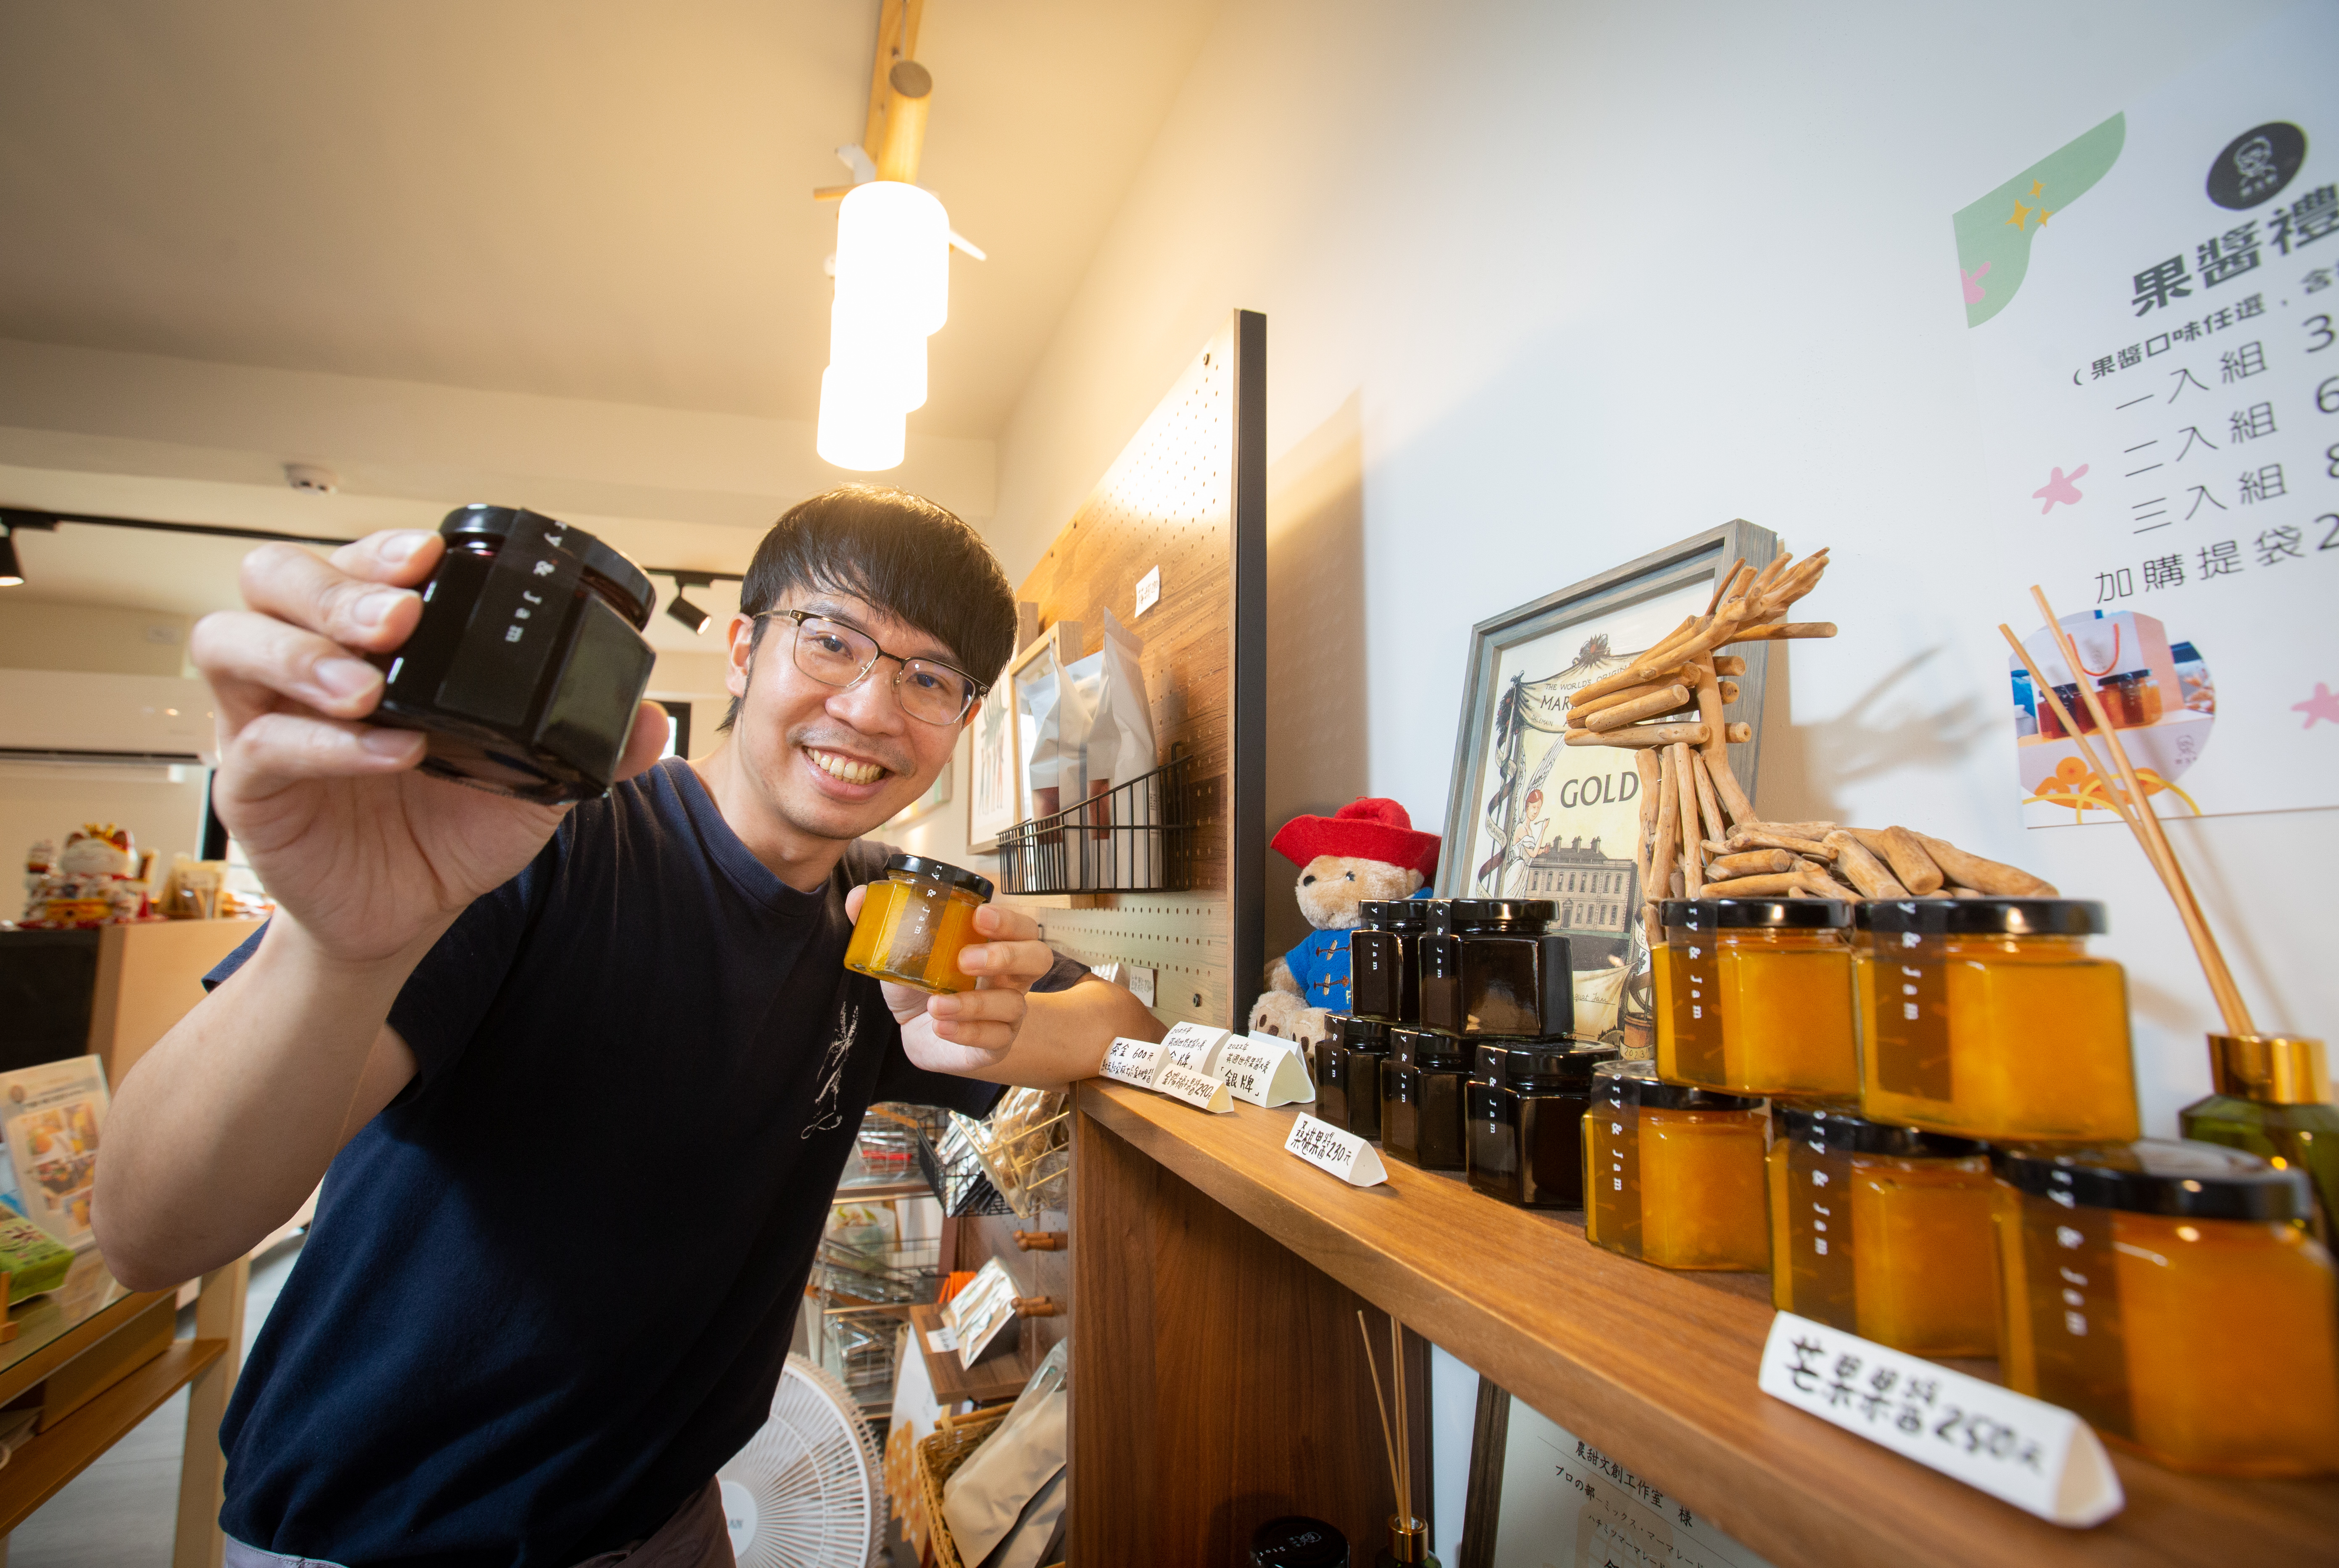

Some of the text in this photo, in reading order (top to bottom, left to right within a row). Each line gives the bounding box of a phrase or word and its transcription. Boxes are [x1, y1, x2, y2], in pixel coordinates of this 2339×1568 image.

[2116, 313, 2336, 410] 一入組 3
[2123, 401, 2278, 477] 二入組
[2132, 463, 2288, 534] 三入組
[504, 590, 543, 642] Jam
[1560, 679, 1591, 690] WORLD'S
[1531, 715, 1554, 726] DALEMAIN
[1560, 771, 1639, 808] GOLD
[1486, 820, 1505, 845] ORANGE
[927, 889, 936, 898] &
[914, 906, 930, 934] Jam
[1437, 927, 1443, 936] &
[1638, 931, 1647, 945] LE
[1690, 974, 1703, 1019] Jam
[1110, 1041, 1154, 1062] 茶金 600元
[1227, 1042, 1249, 1052] 2022年
[1402, 1053, 1407, 1062] &
[1624, 1047, 1645, 1060] 2023
[1226, 1052, 1271, 1074] 英國世界果醬大賽
[1221, 1066, 1259, 1097] 「銀牌」
[1489, 1077, 1496, 1087] &
[1612, 1122, 1622, 1135] &
[1612, 1149, 1623, 1191] Jam
[1576, 1440, 1663, 1508] 農甜文創工作室
